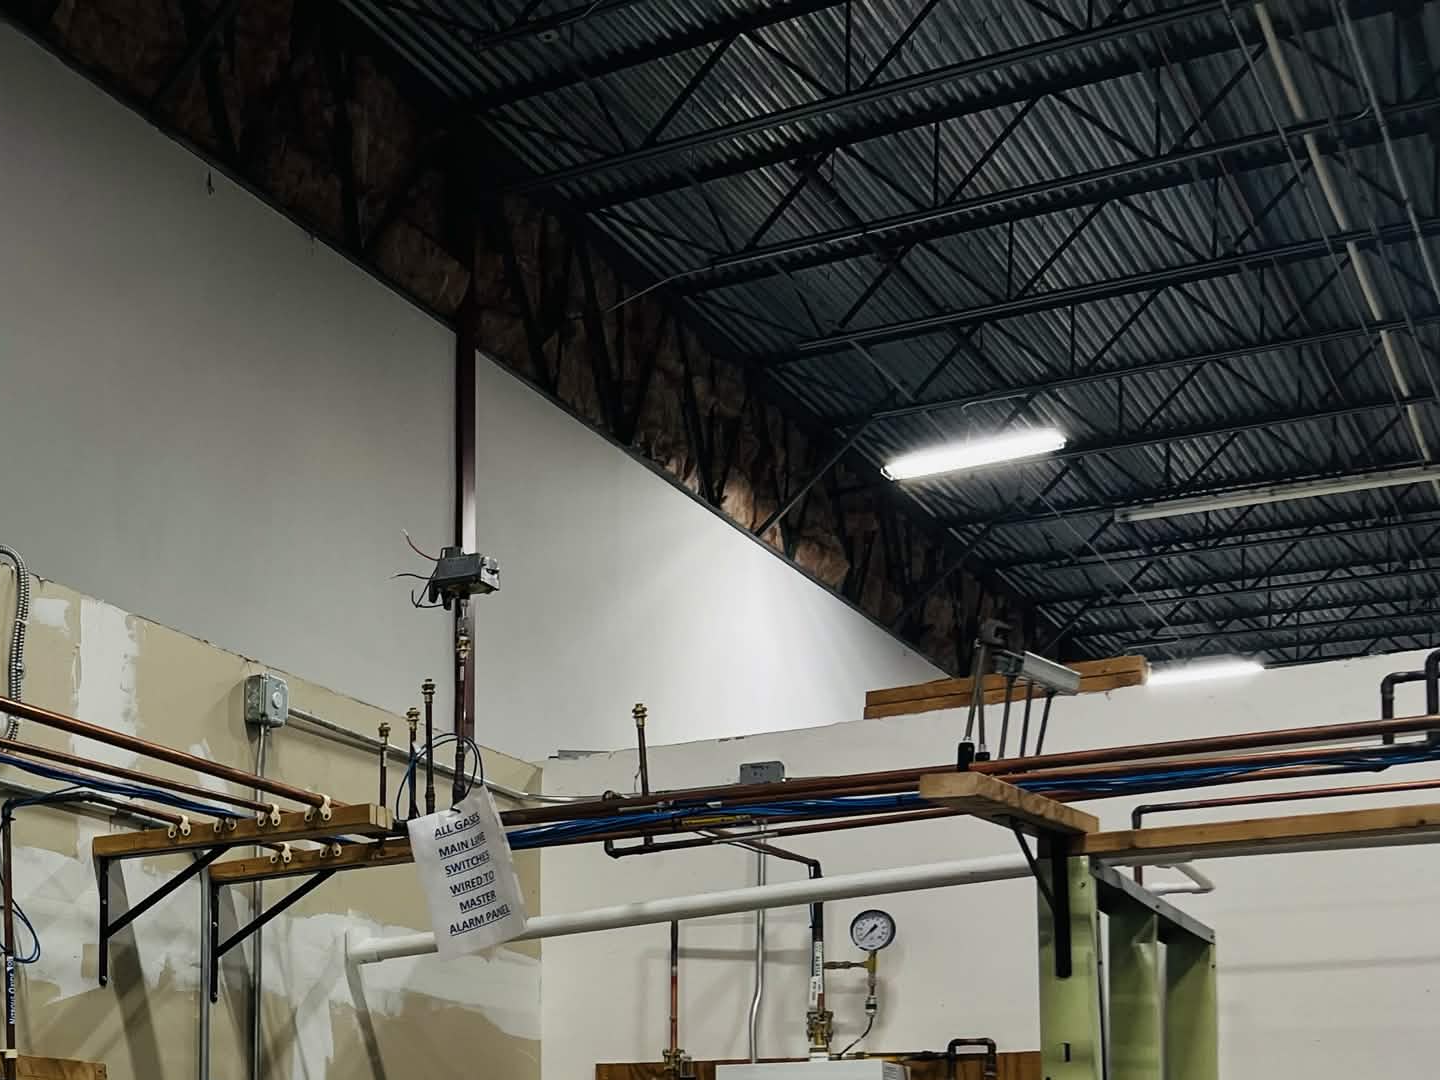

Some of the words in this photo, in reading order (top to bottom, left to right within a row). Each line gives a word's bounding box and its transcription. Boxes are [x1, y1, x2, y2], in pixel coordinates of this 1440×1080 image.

[434, 825, 454, 838] ALL
[438, 840, 469, 858] MAIN
[444, 850, 490, 875] SWITCHES
[449, 875, 483, 895] WIRED
[484, 870, 495, 882] TO
[459, 889, 497, 911] MASTER
[450, 915, 484, 934] ALARM
[485, 903, 510, 921] PANEL
